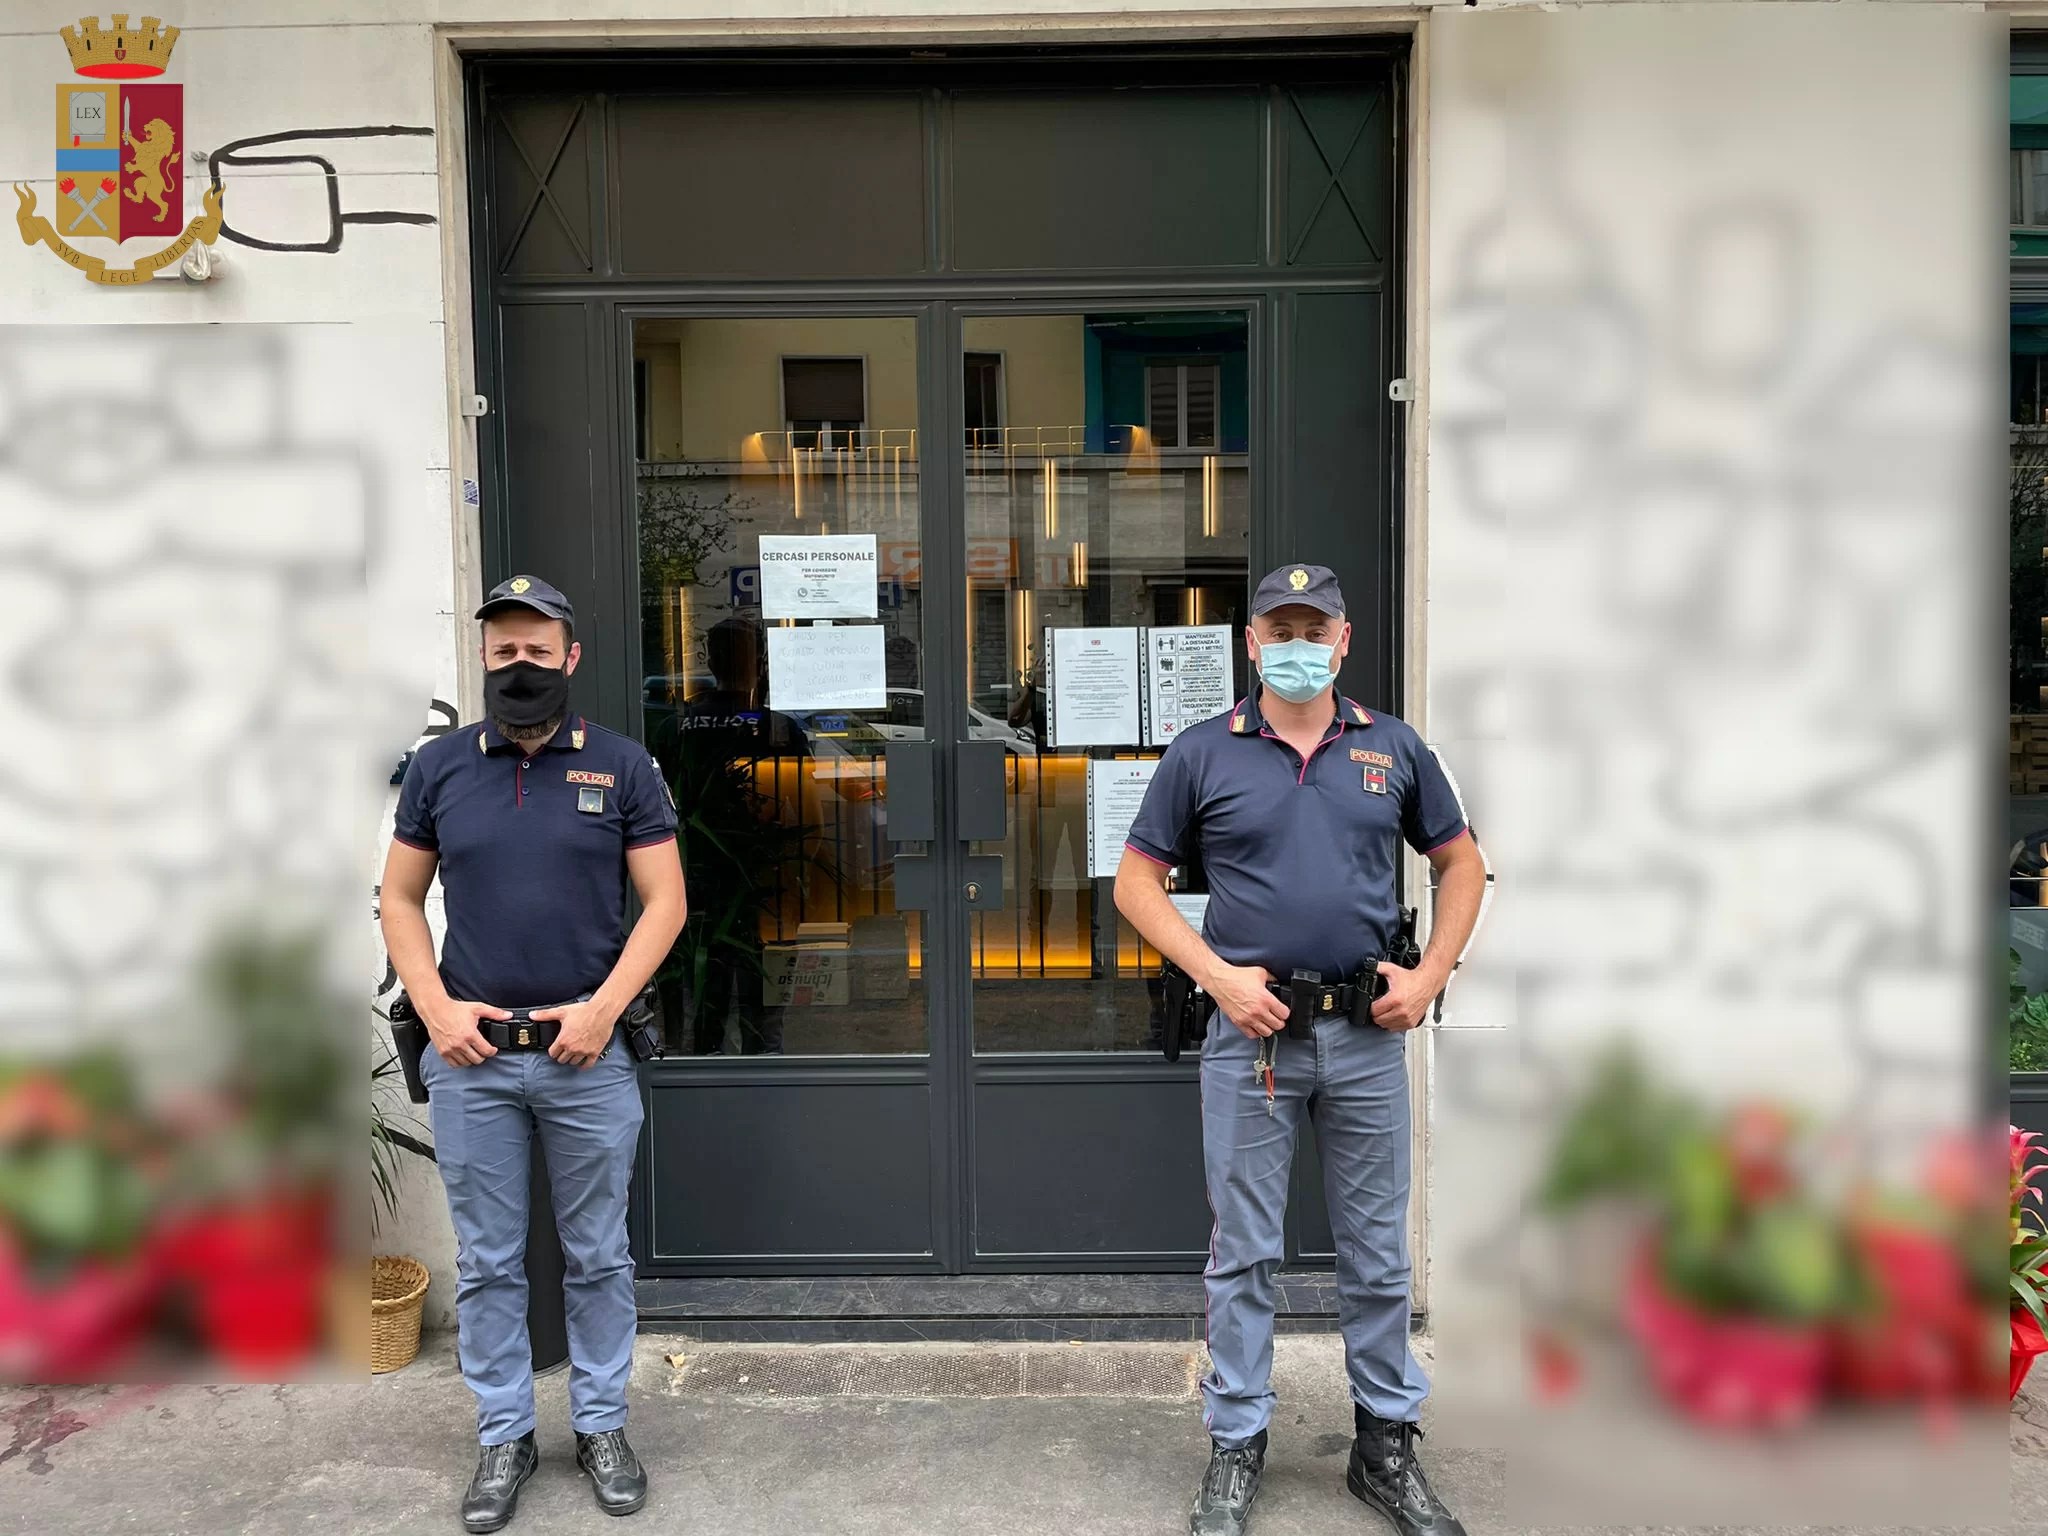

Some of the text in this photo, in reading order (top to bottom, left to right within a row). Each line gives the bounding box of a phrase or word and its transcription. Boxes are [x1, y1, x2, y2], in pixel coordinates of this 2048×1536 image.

[762, 552, 874, 561] CERCASI PERSONALE
[1352, 751, 1390, 766] POLIZIA
[569, 772, 612, 786] POLIZIA
